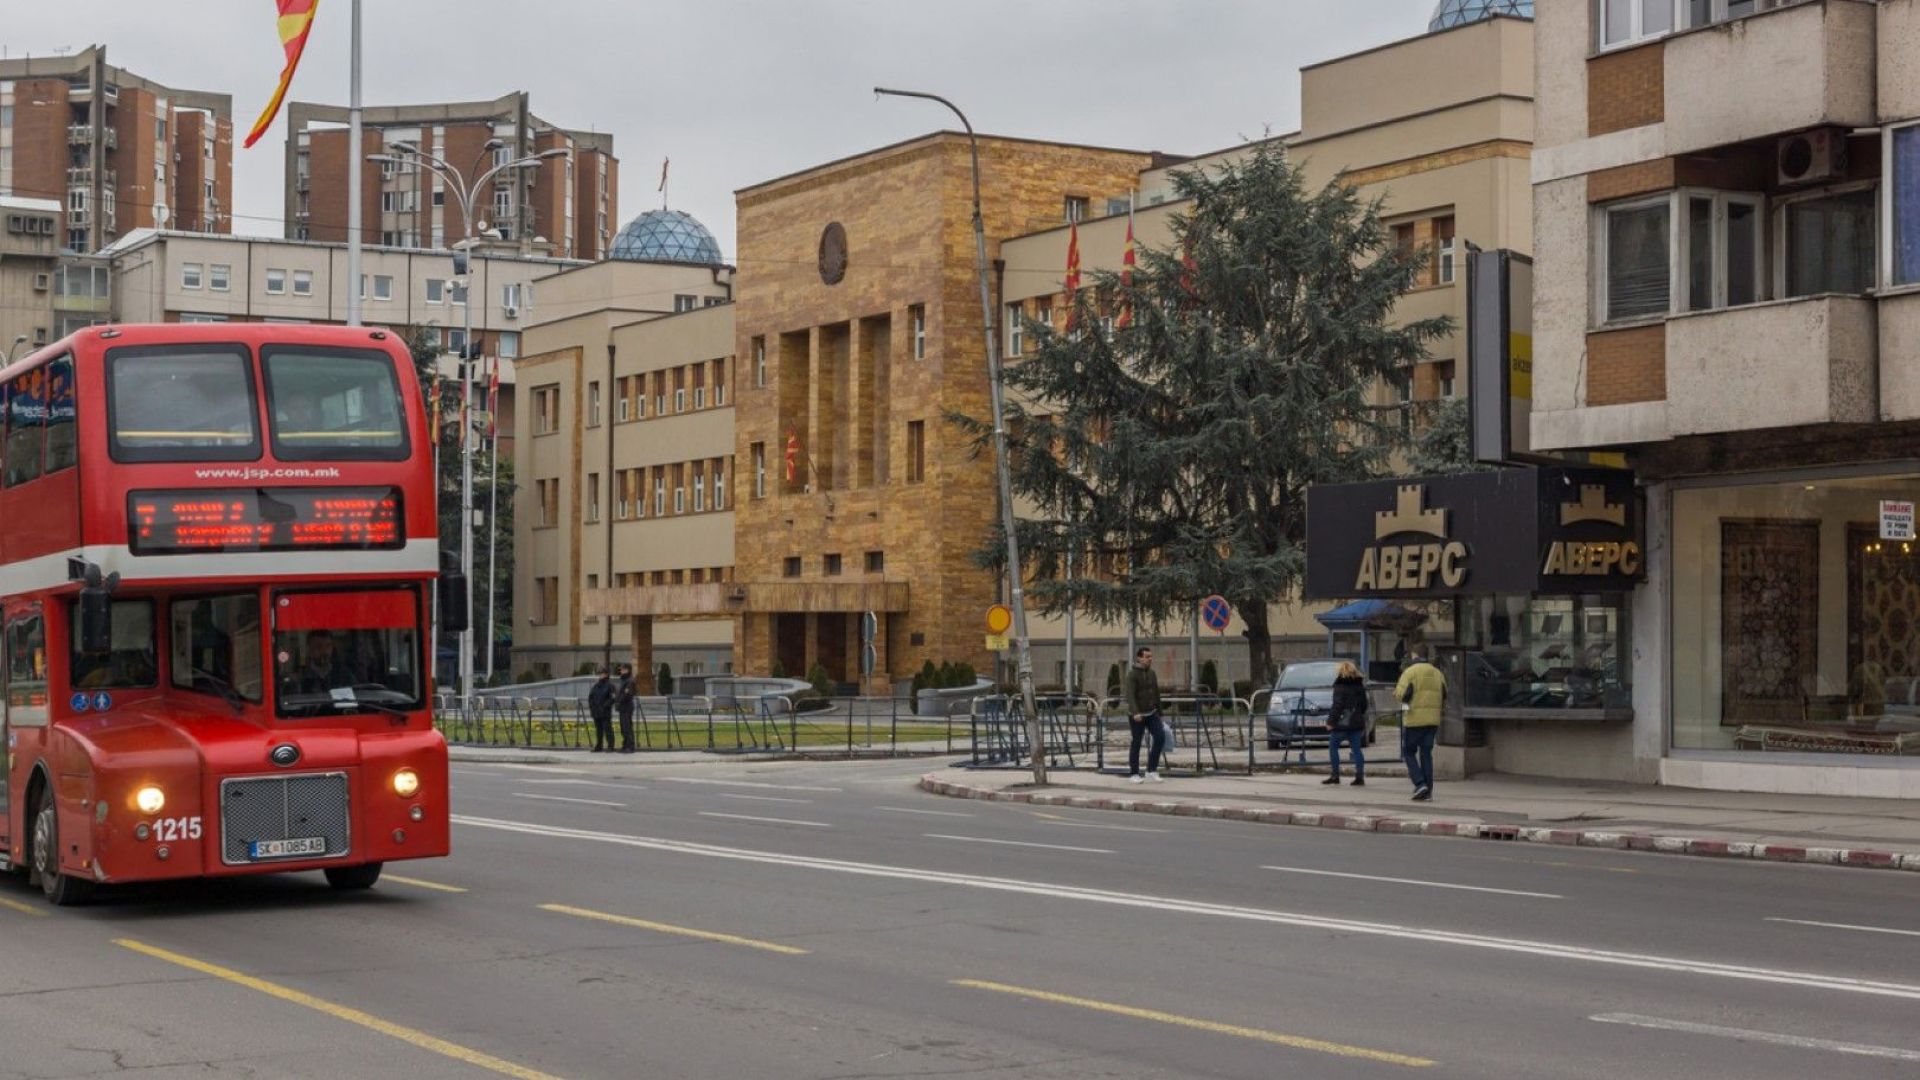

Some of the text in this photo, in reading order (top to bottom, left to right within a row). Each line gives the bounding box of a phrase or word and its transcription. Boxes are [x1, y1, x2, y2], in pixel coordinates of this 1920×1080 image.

[195, 466, 340, 480] www.jsp.com.mk
[1355, 541, 1467, 590] АВЕРС
[1542, 541, 1640, 575] АВЕРС
[153, 816, 202, 842] 1215
